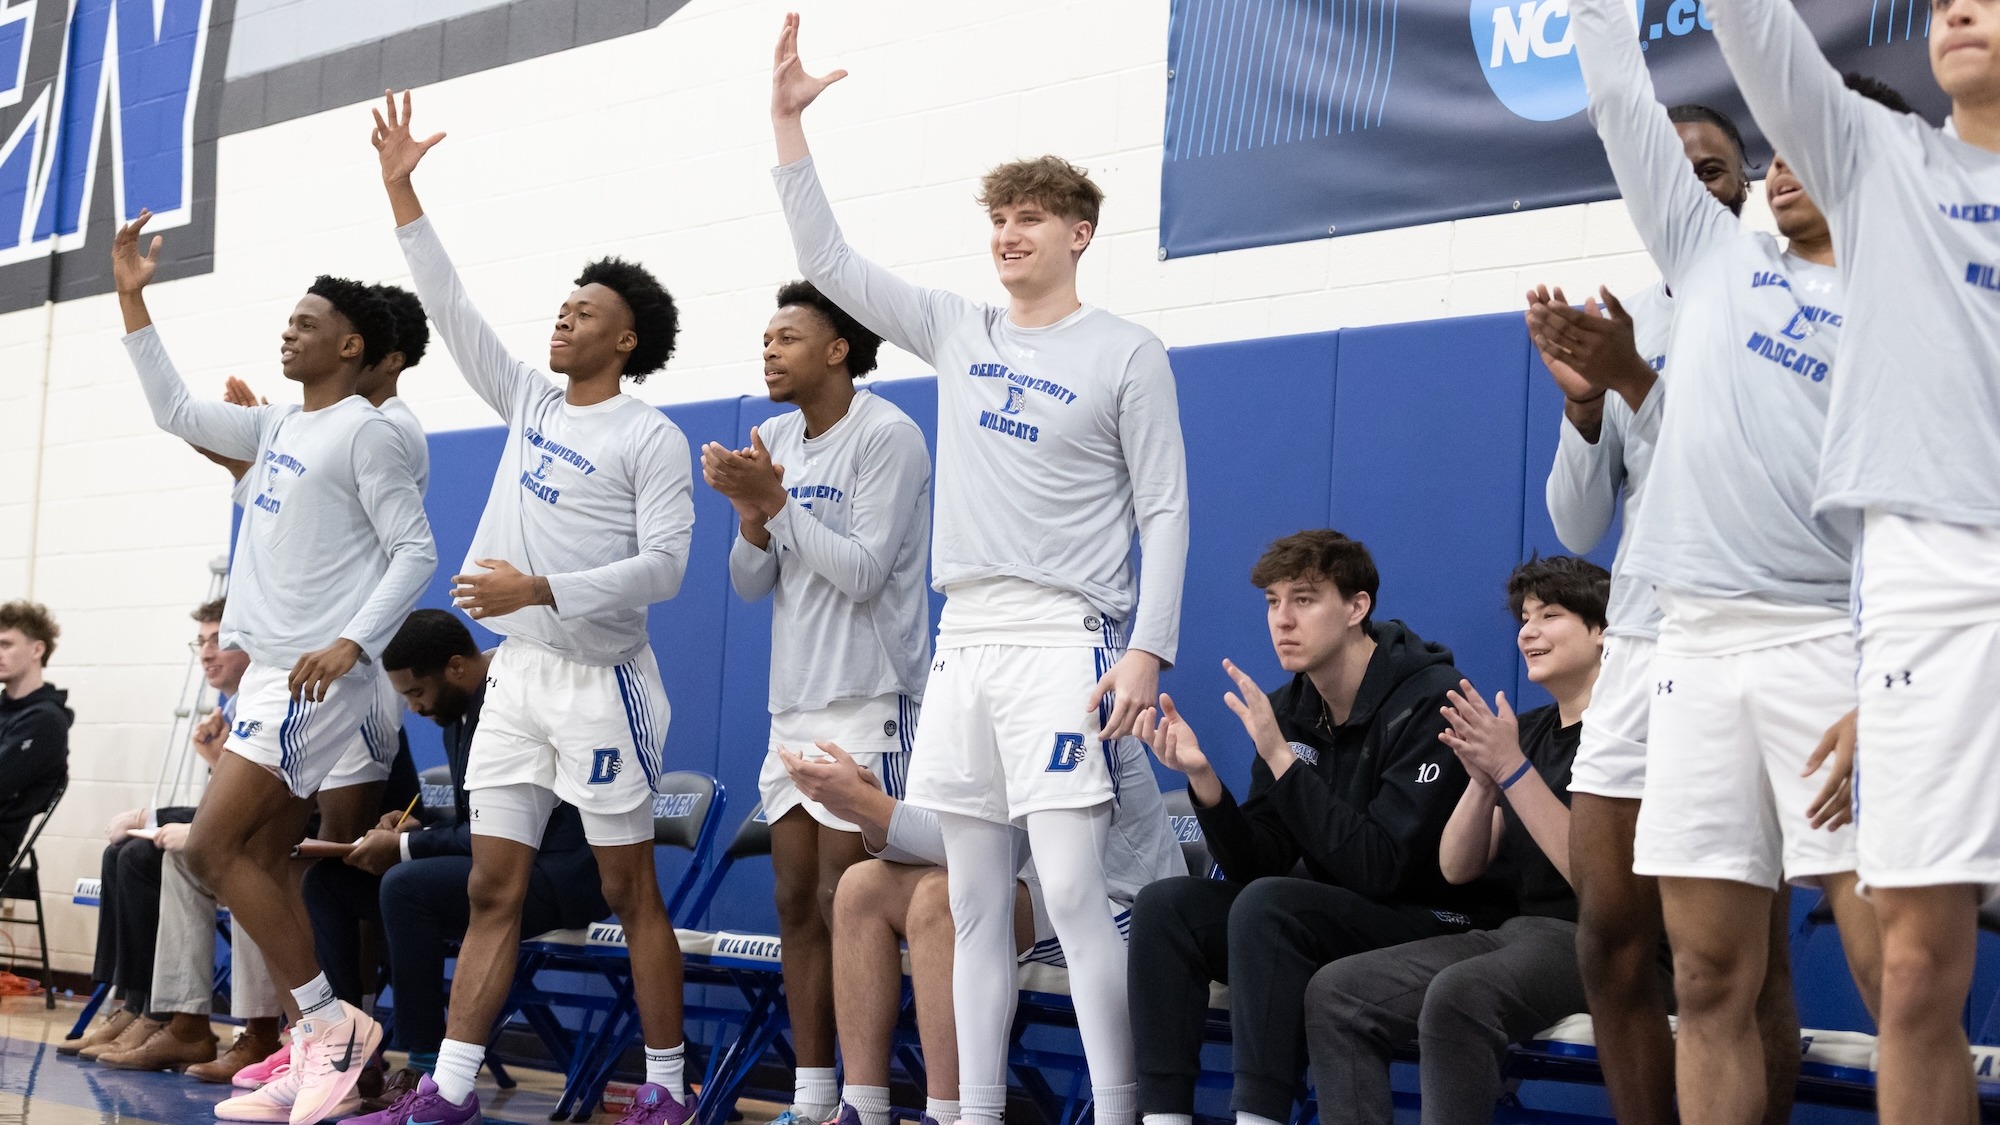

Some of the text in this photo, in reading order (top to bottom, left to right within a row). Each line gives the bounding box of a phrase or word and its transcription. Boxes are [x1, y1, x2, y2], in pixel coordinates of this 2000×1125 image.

[979, 410, 1039, 442] WILDCATS
[543, 440, 597, 476] UNIVERSITY
[1414, 762, 1440, 783] 10
[653, 793, 703, 818] EMEN
[717, 938, 781, 958] WILDCATS
